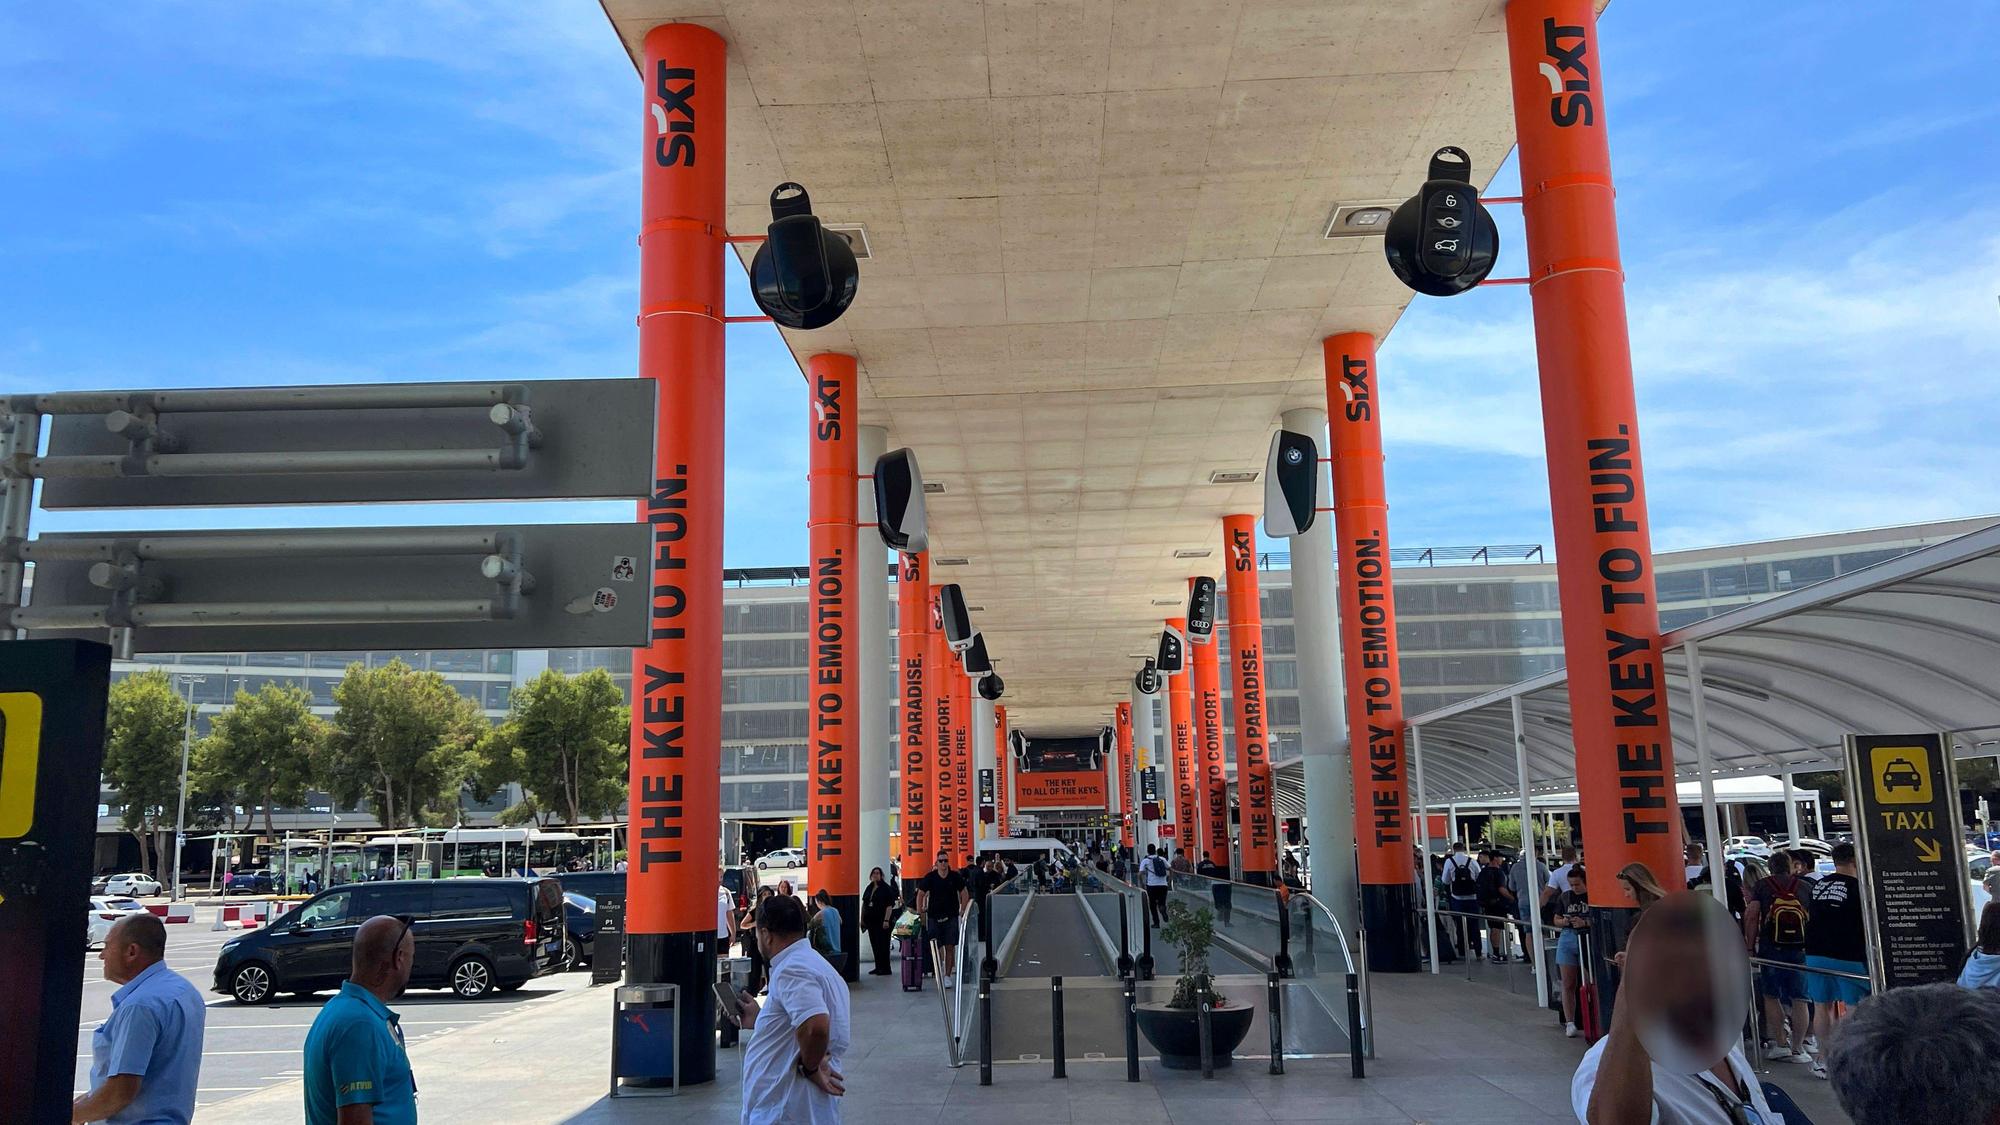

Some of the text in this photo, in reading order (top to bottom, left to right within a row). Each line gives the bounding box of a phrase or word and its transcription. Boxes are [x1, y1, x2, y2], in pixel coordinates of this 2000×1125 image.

[652, 59, 696, 168] SIXT
[1539, 17, 1593, 127] SIXT
[815, 375, 840, 441] SIXT
[1339, 355, 1370, 422] SIXT
[648, 464, 688, 570] FUN.
[903, 551, 920, 582] SIX
[1232, 528, 1251, 571] SIXT
[1587, 423, 1669, 844] THE KEY TO FUN.
[642, 663, 686, 760] KEY
[817, 548, 843, 861] THE KEY TO EMOTION.
[1356, 529, 1402, 848] THE KEY TO EMOTION.
[907, 653, 924, 857] THE KEY TO PARADISE.
[938, 694, 953, 853] THE KEY TO COMFORT.
[956, 725, 969, 853] THE KEY TO FEEL FREE.
[1022, 786, 1101, 796] TO ALL OF THE KEYS.
[1045, 779, 1059, 787] THE
[1177, 720, 1194, 849] THE KEY TO FEEL FREE.
[1204, 688, 1225, 849] THE KEY TO COMFORT.
[1242, 644, 1268, 849] THE KEY TO PARADISE.
[640, 774, 684, 874] THE
[997, 801, 1004, 811] TO
[1881, 811, 1934, 830] TAXI
